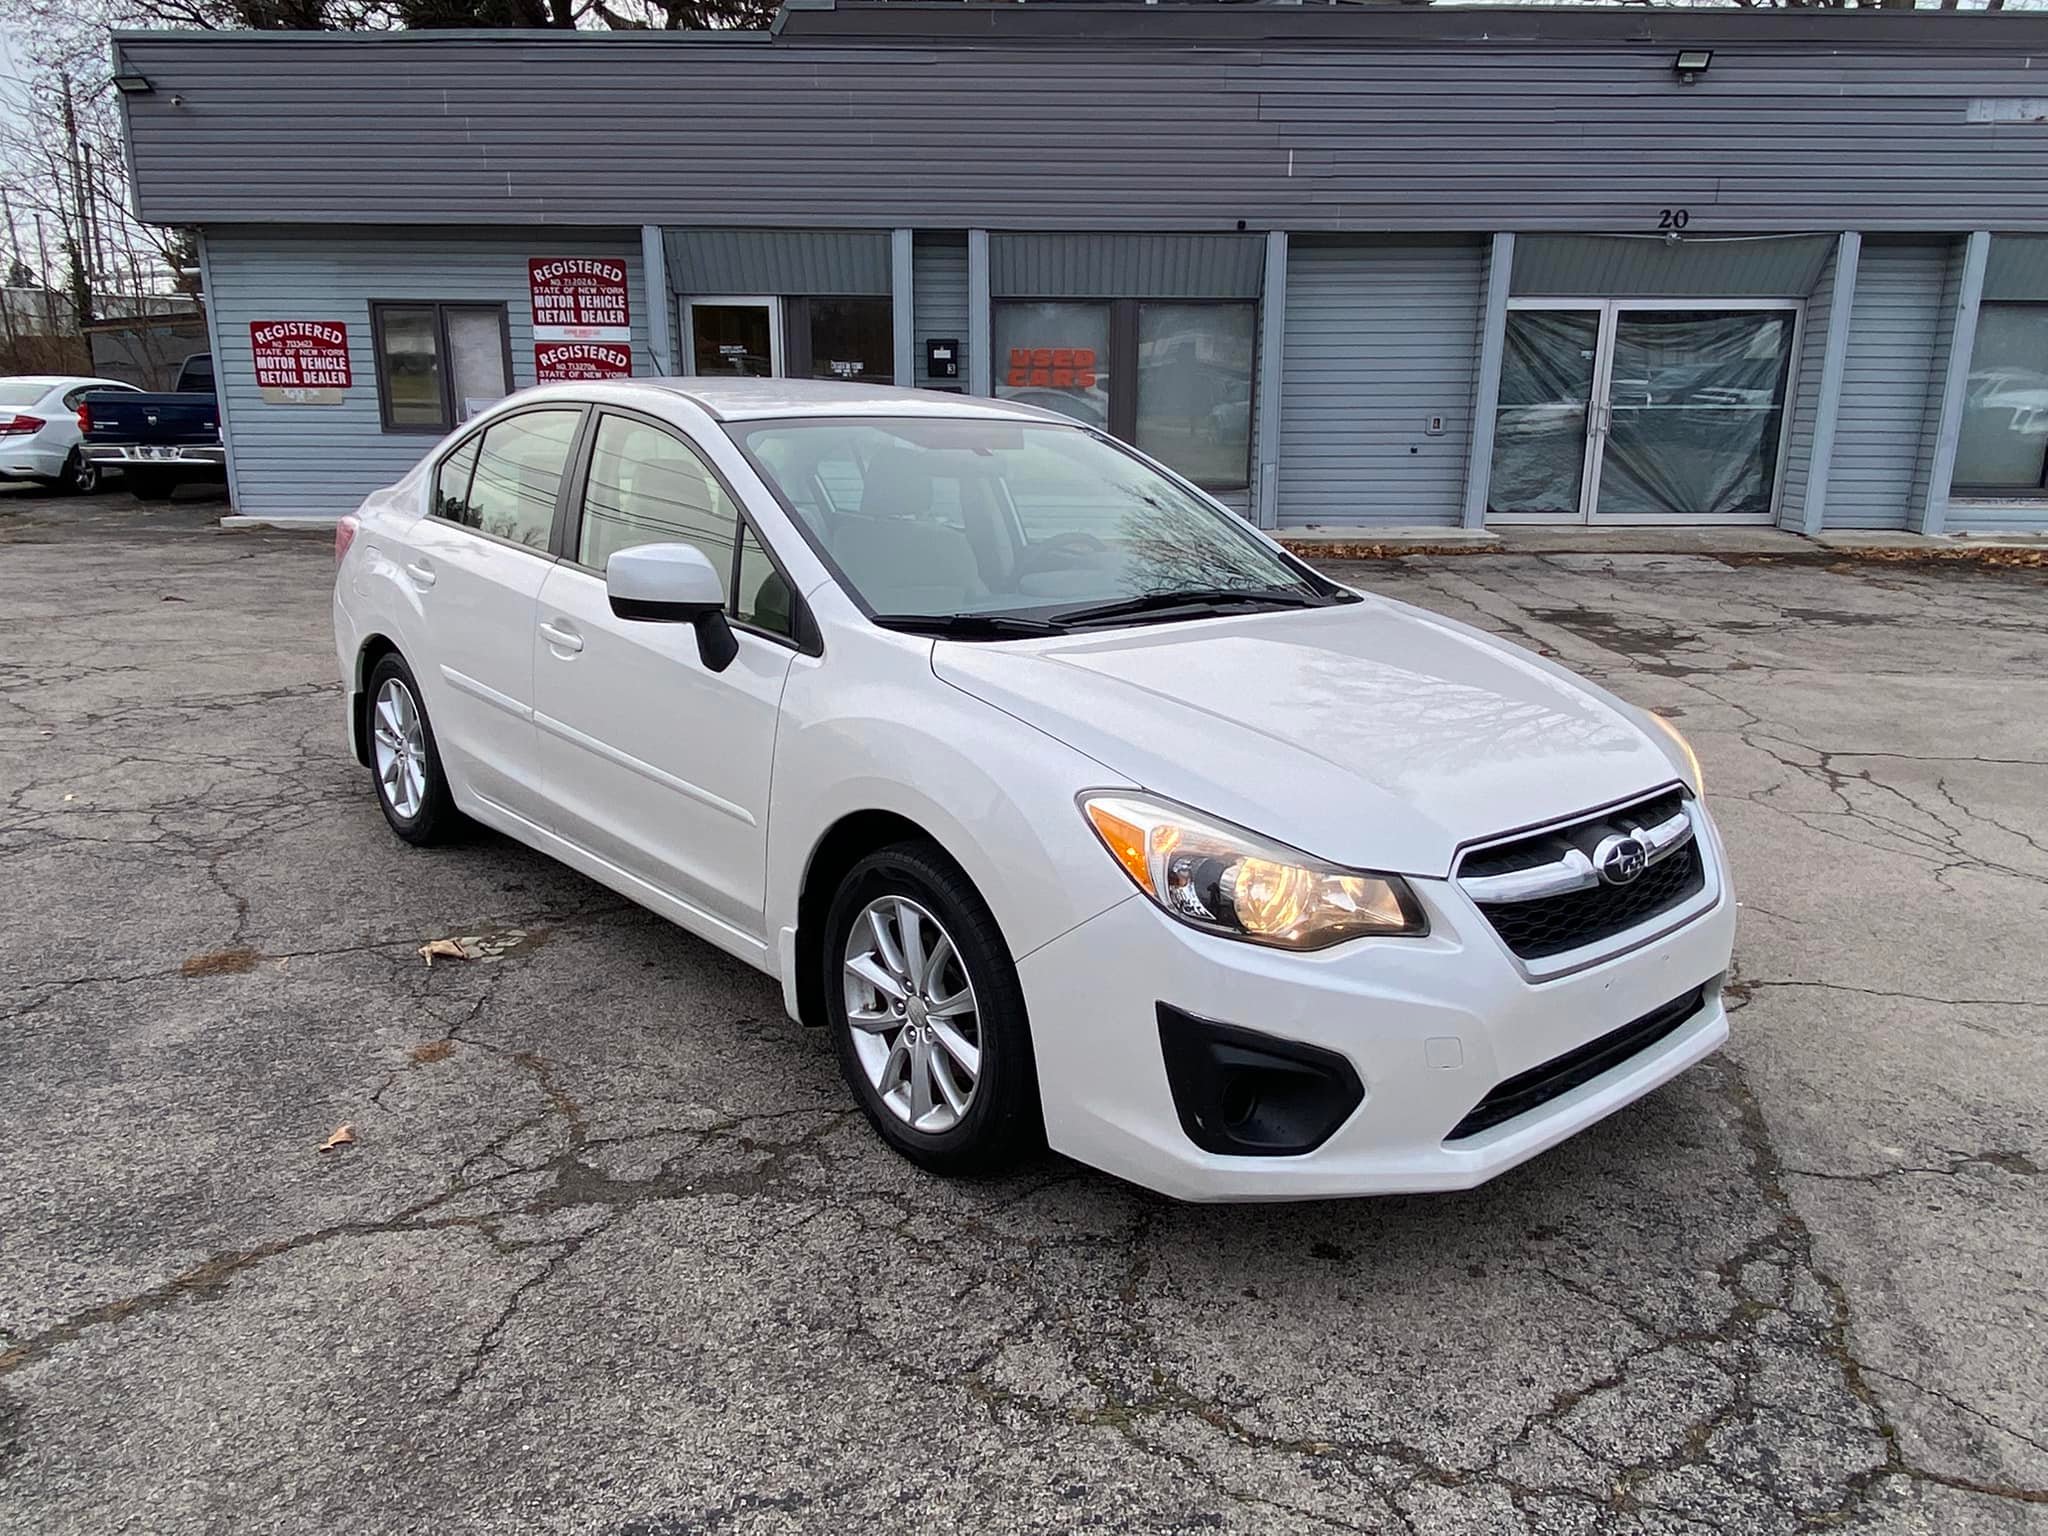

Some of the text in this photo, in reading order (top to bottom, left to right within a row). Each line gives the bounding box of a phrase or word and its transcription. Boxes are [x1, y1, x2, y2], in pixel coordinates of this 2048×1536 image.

[1658, 209, 1689, 228] 20
[533, 260, 623, 282] REGISTERED
[533, 286, 560, 294] STATE
[534, 295, 625, 309] MOTOR VEHICLE
[537, 310, 625, 324] RETAIL DEALER
[255, 322, 342, 344] REGISTERED
[255, 348, 282, 356] STATE
[539, 345, 627, 367] REGISTERED
[1011, 347, 1096, 368] USED
[256, 356, 347, 370] MOTOR VEHICLE
[260, 370, 347, 384] RETAIL DEALER
[583, 371, 602, 379] NEW
[1008, 368, 1096, 387] CARS
